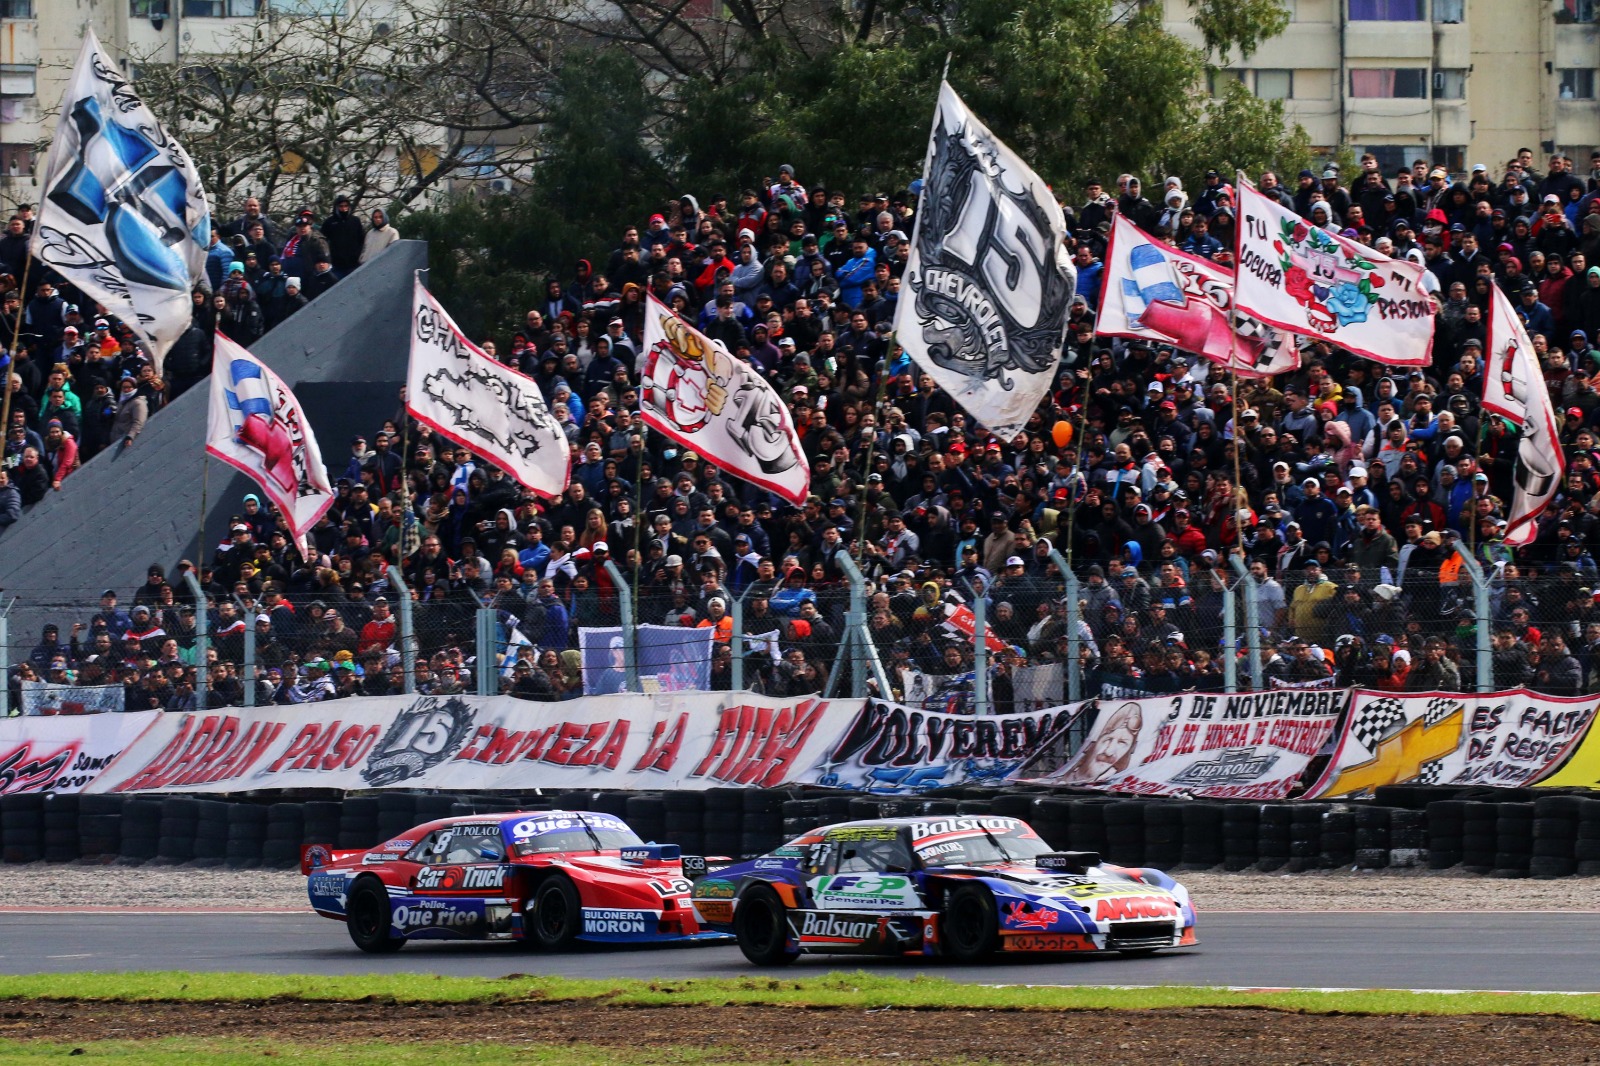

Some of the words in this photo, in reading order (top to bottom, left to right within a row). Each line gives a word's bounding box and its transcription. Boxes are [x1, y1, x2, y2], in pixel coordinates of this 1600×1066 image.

[1246, 214, 1268, 241] TU
[1240, 243, 1283, 289] LOCURA
[1185, 274, 1233, 308] 15
[924, 267, 1008, 360] CHEVROLET
[1377, 297, 1431, 320] PASION
[1168, 697, 1182, 720] 3
[1190, 696, 1217, 719] DE
[1222, 691, 1345, 719] NOVIEMBRE
[1470, 704, 1506, 735] ES
[267, 720, 381, 773] PASO
[460, 719, 631, 771] EMPIEZA
[634, 712, 690, 773] LA
[1172, 723, 1201, 756] DEL
[1201, 722, 1250, 751] HINCHA
[1250, 720, 1270, 746] DE
[1466, 735, 1498, 762] DE
[1191, 761, 1264, 777] CHEVROLET
[452, 826, 462, 836] EL
[463, 826, 500, 836] POLACO
[512, 818, 568, 838] Que
[909, 818, 1021, 841] Balsuar
[684, 858, 705, 870] SGB
[416, 866, 445, 888] Car
[462, 865, 506, 888] Truck
[420, 900, 446, 909] Pollos
[824, 895, 878, 905] General
[1096, 895, 1178, 922] AKRON
[391, 905, 432, 929] Que
[435, 906, 478, 926] rico
[584, 911, 644, 920] BULONERA
[584, 920, 646, 932] MORON
[802, 912, 878, 939] Balsuar
[1012, 935, 1079, 950] Kubota
